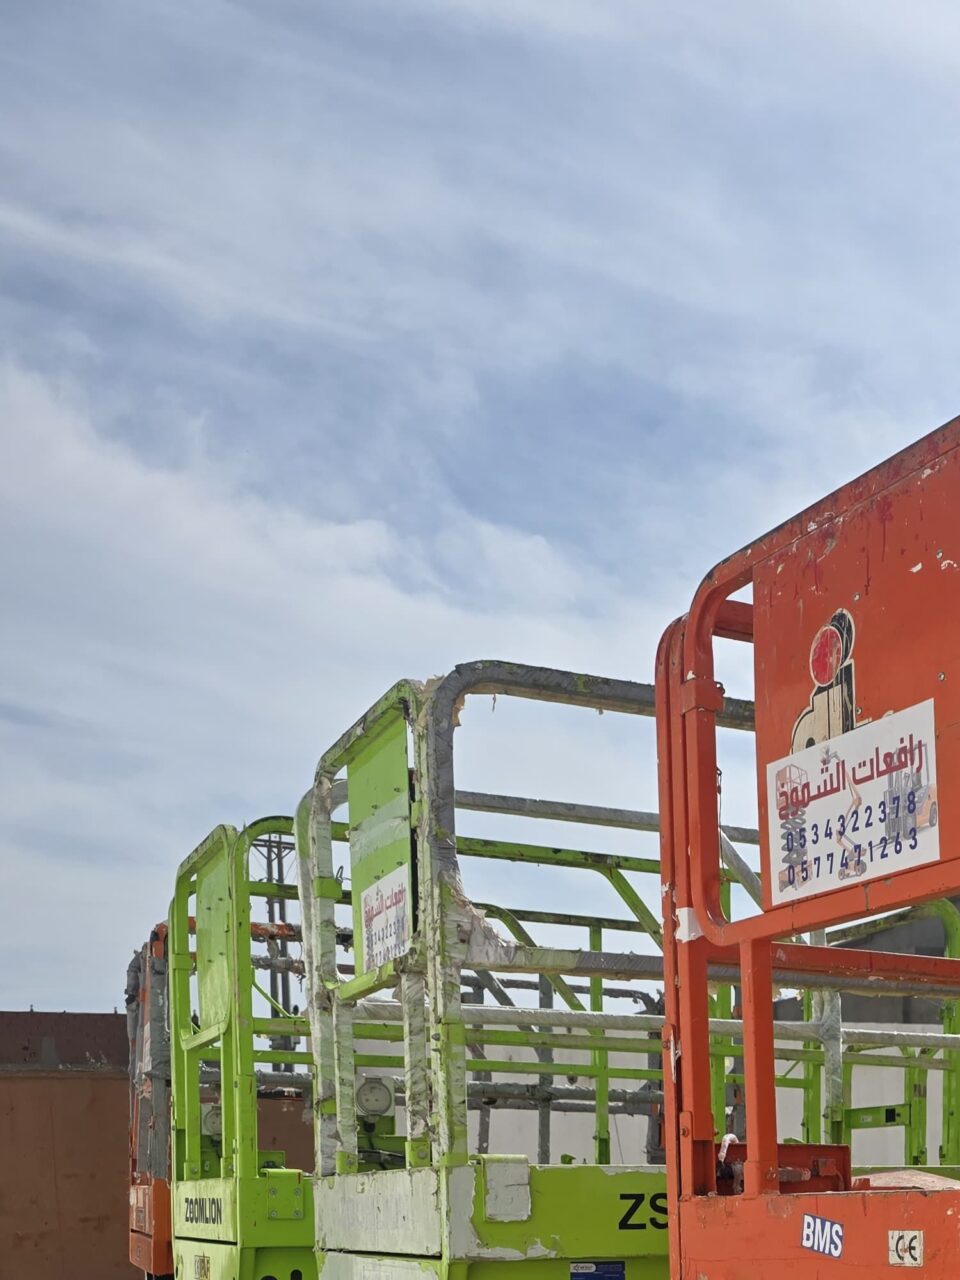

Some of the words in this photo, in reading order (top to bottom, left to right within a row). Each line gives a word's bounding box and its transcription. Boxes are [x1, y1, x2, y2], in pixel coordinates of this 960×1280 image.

[851, 734, 923, 786] رافعات
[778, 759, 846, 821] الشموخ
[786, 790, 917, 852] 0534322378
[787, 827, 918, 886] 0577471263
[184, 1197, 222, 1225] ZOOMLION
[802, 1214, 843, 1258] BMS
